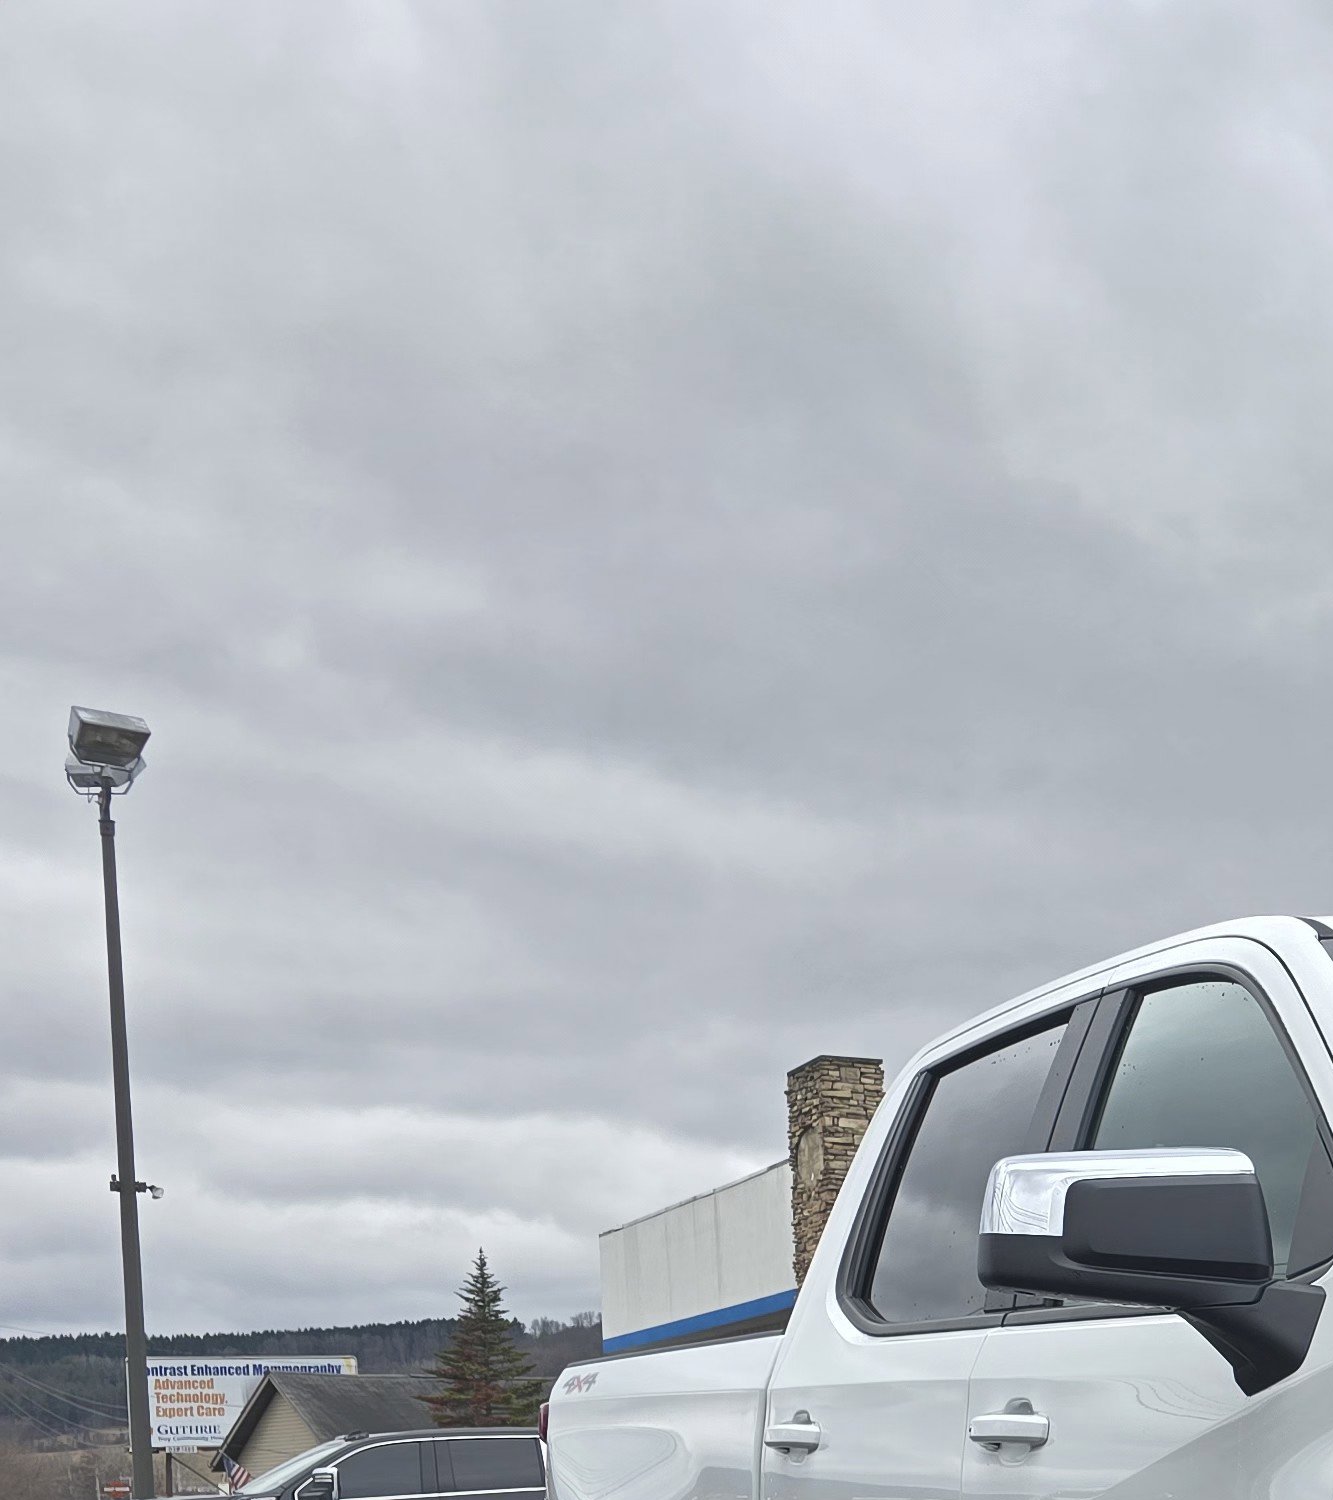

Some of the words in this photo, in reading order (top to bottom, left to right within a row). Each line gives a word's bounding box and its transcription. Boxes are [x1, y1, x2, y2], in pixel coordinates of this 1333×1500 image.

[146, 1365, 189, 1377] ontrast
[190, 1364, 250, 1377] Enhanced
[154, 1378, 215, 1390] Advanced
[155, 1391, 228, 1406] Technology.
[155, 1405, 194, 1419] Expert
[196, 1404, 226, 1417] Care
